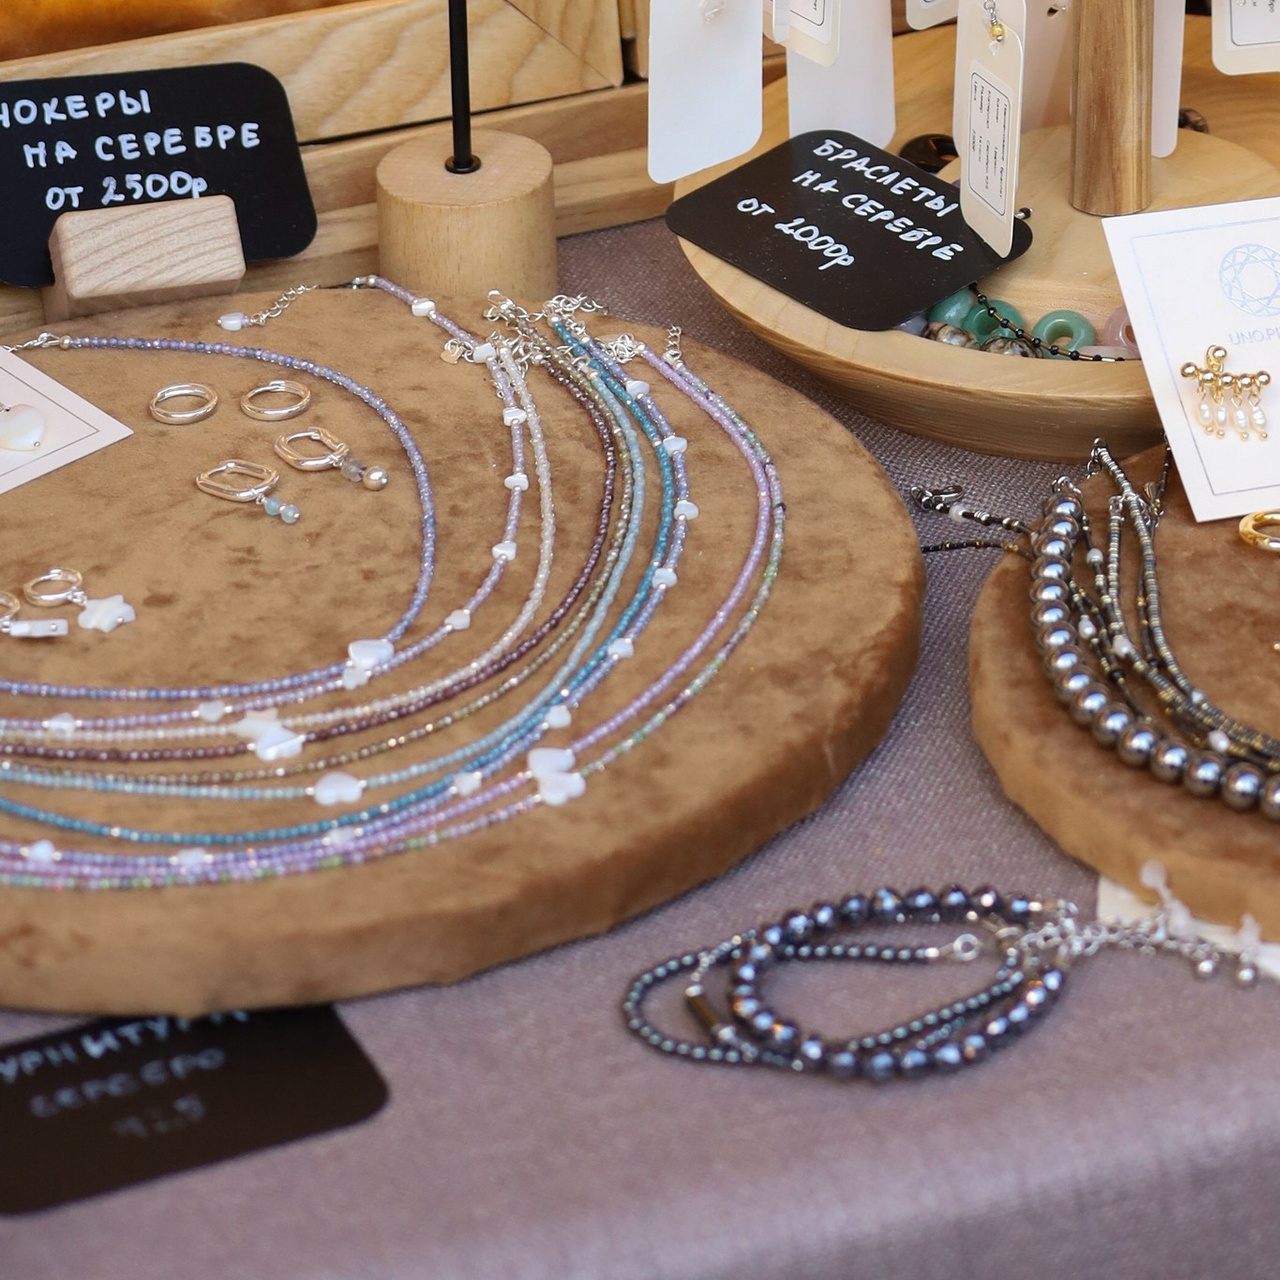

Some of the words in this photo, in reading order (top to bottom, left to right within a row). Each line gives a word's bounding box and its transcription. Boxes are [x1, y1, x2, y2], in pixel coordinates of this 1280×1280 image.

[23, 140, 77, 168] НА
[95, 122, 260, 161] СЕРЕБРЕ
[45, 186, 84, 210] ОТ
[813, 139, 959, 217] БРАСЛЕТЫ
[737, 197, 775, 216] ОТ
[792, 170, 839, 193] НА
[842, 194, 964, 261] СЕРЕБРЕ
